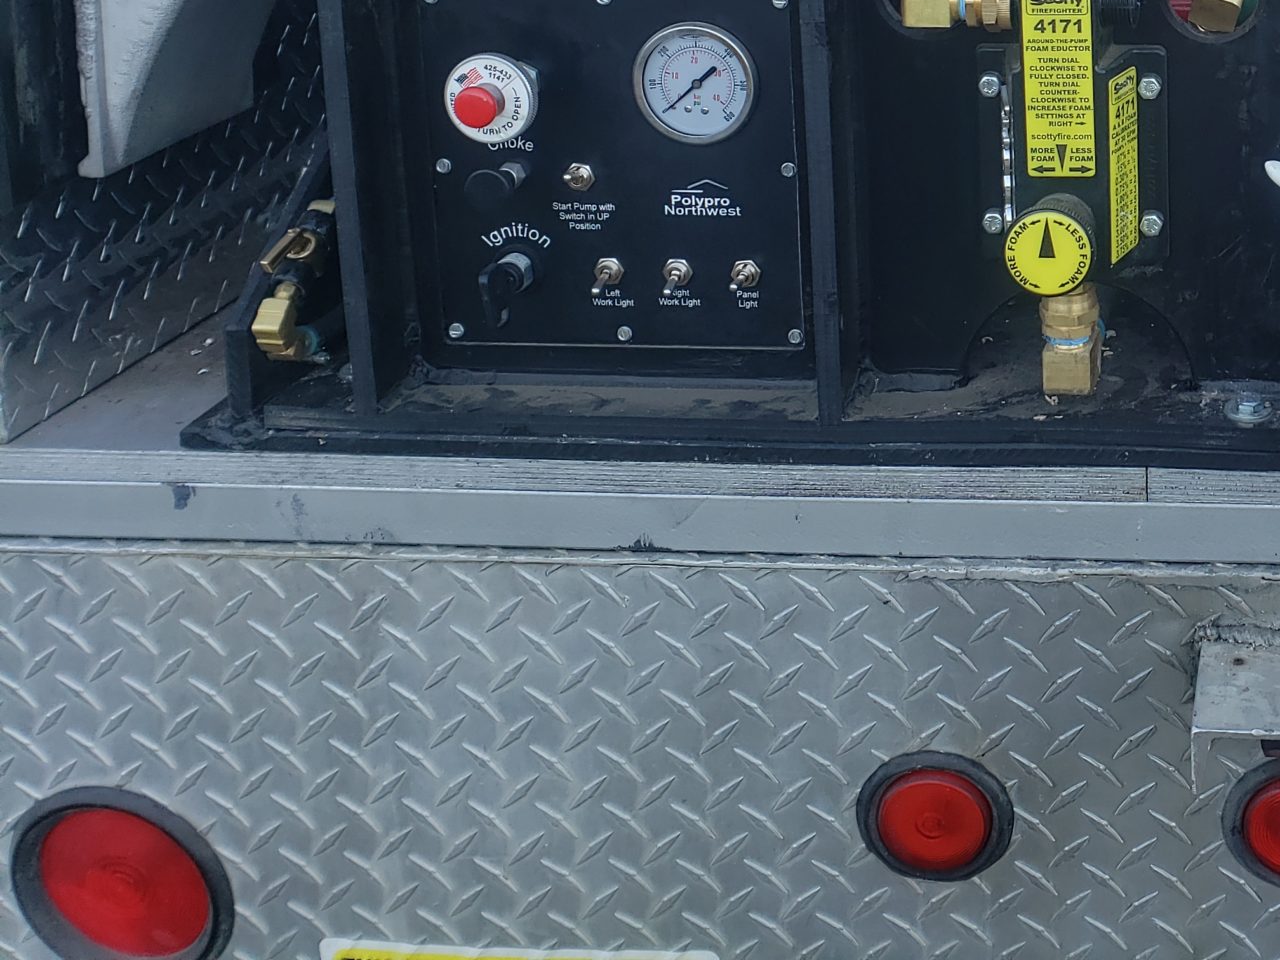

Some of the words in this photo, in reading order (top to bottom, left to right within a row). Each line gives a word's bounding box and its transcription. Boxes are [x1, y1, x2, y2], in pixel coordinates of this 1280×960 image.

[1034, 19, 1083, 34] 4171
[502, 121, 514, 132] TO
[512, 96, 521, 121] OPEN
[1115, 97, 1135, 119] 4171
[1031, 132, 1093, 141] scottyfire.com
[552, 201, 572, 210] Start
[573, 202, 597, 212] Pump
[598, 203, 616, 211] with
[671, 194, 730, 208] Polypro
[559, 212, 586, 220] Switch
[597, 212, 610, 221] UP
[664, 205, 742, 217] Northwest
[569, 222, 601, 230] Position
[482, 222, 551, 249] Ignition
[1007, 222, 1029, 251] FOAM
[1065, 223, 1087, 250] LESS
[1007, 255, 1030, 286] MORE
[1068, 253, 1088, 285] FOAM
[605, 289, 621, 297] Left
[736, 290, 759, 299] Panel
[592, 298, 613, 306] Work
[614, 298, 635, 308] Light
[658, 298, 680, 306] Work
[681, 298, 701, 307] Light
[738, 300, 758, 309] Light
